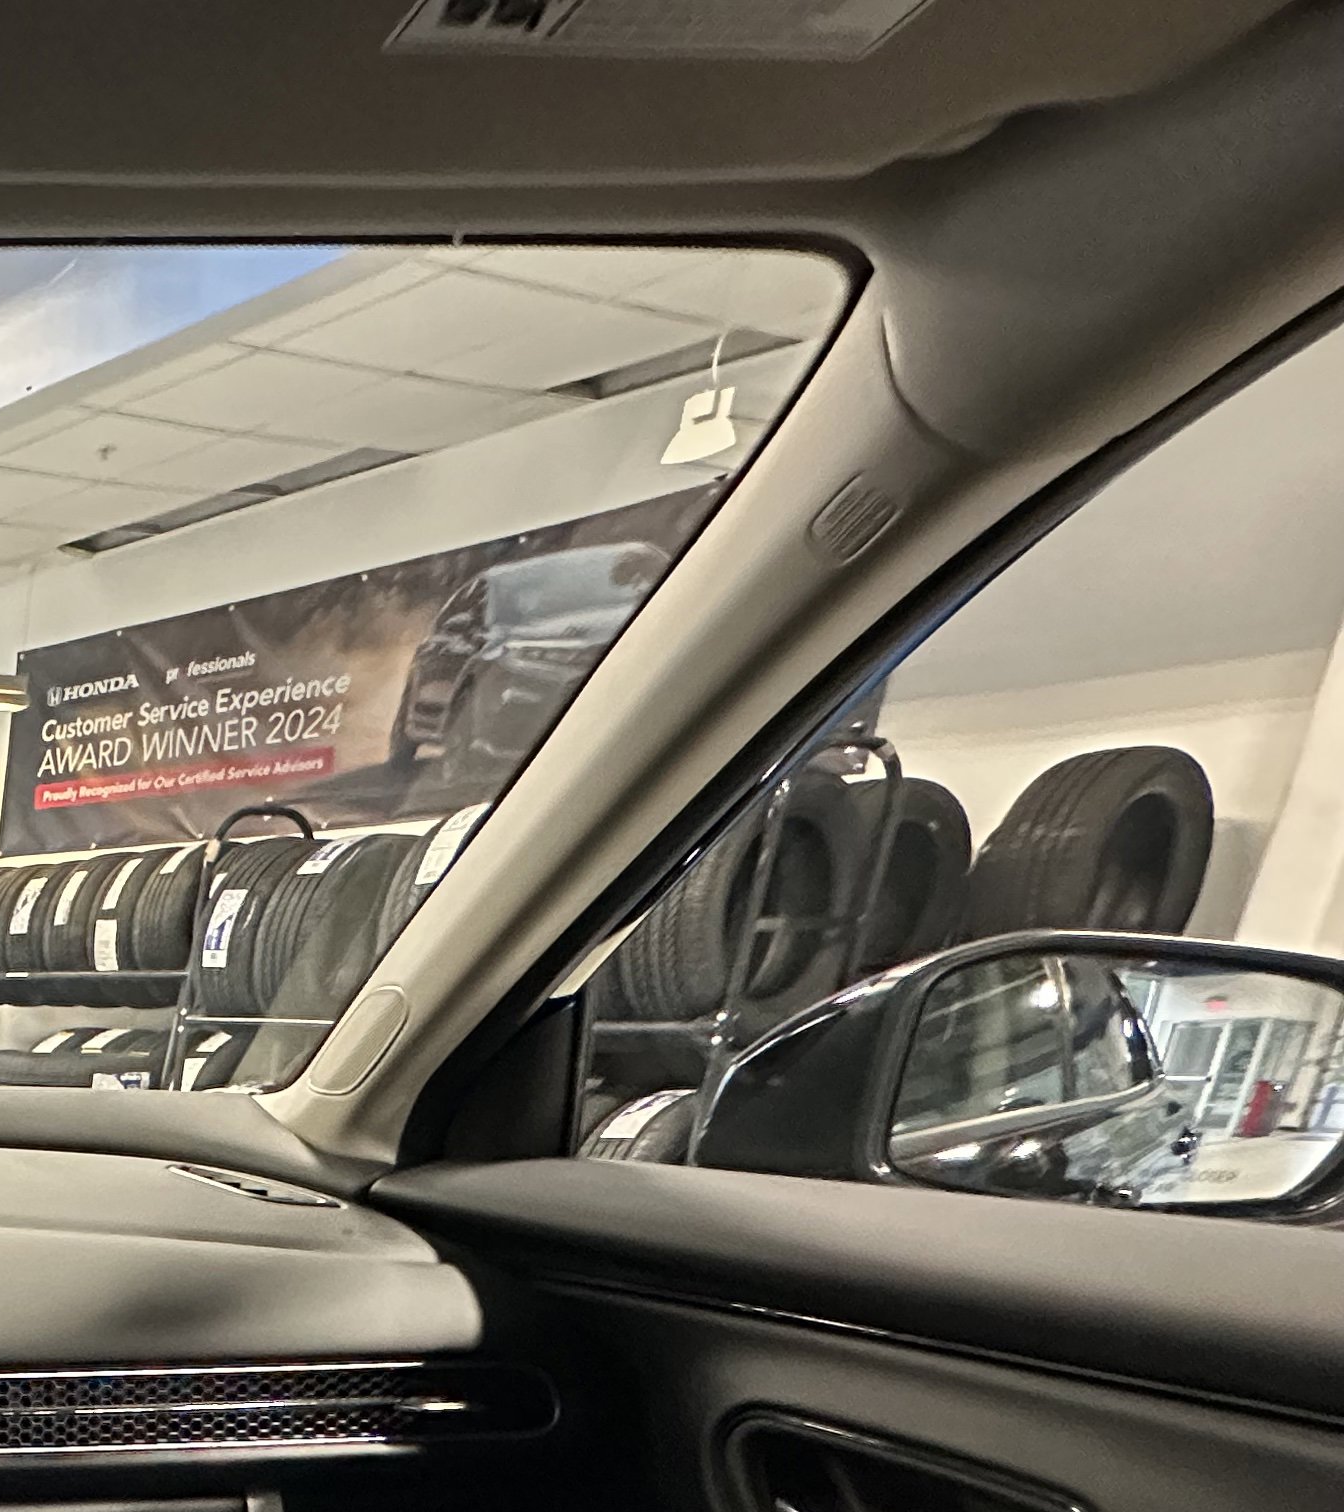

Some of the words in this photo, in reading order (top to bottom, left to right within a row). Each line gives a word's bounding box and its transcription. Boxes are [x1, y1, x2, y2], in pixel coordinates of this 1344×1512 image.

[41, 711, 134, 742] Customer
[137, 695, 210, 728] Service
[215, 673, 352, 716] Experience
[62, 673, 140, 702] HONDA
[36, 736, 133, 778] AWARD
[142, 715, 258, 762] WINNER
[265, 702, 345, 746] 2024
[42, 786, 77, 802] Proudly
[79, 779, 136, 799] Recognized
[137, 778, 152, 790] for
[154, 776, 175, 789] Our
[178, 768, 225, 786] Certified
[227, 764, 271, 780] Service
[272, 758, 324, 775] Advisors
